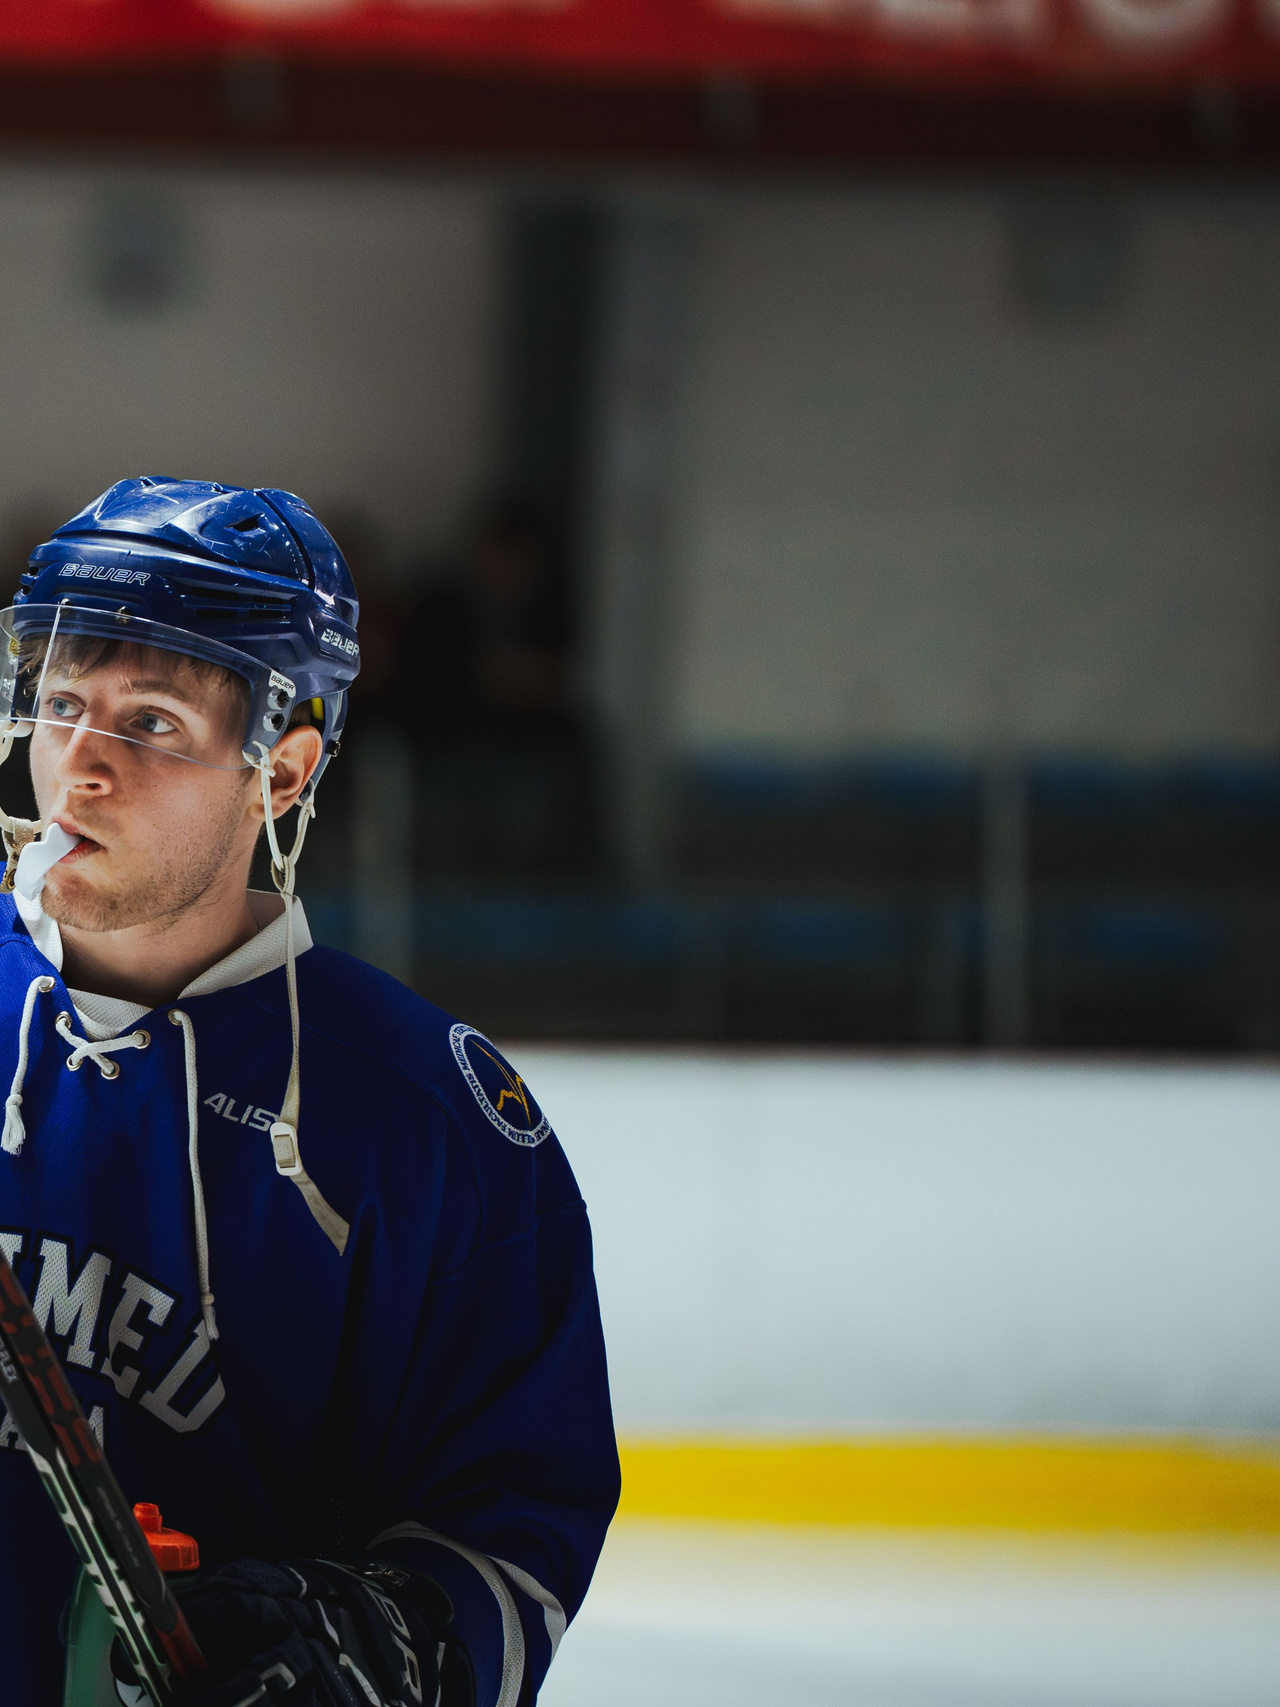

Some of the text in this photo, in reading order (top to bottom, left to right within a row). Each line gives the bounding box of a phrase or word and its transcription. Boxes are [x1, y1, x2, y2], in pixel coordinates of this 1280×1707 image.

[58, 563, 152, 586] BAUER
[320, 628, 360, 658] BAUER
[271, 674, 295, 690] BAUER
